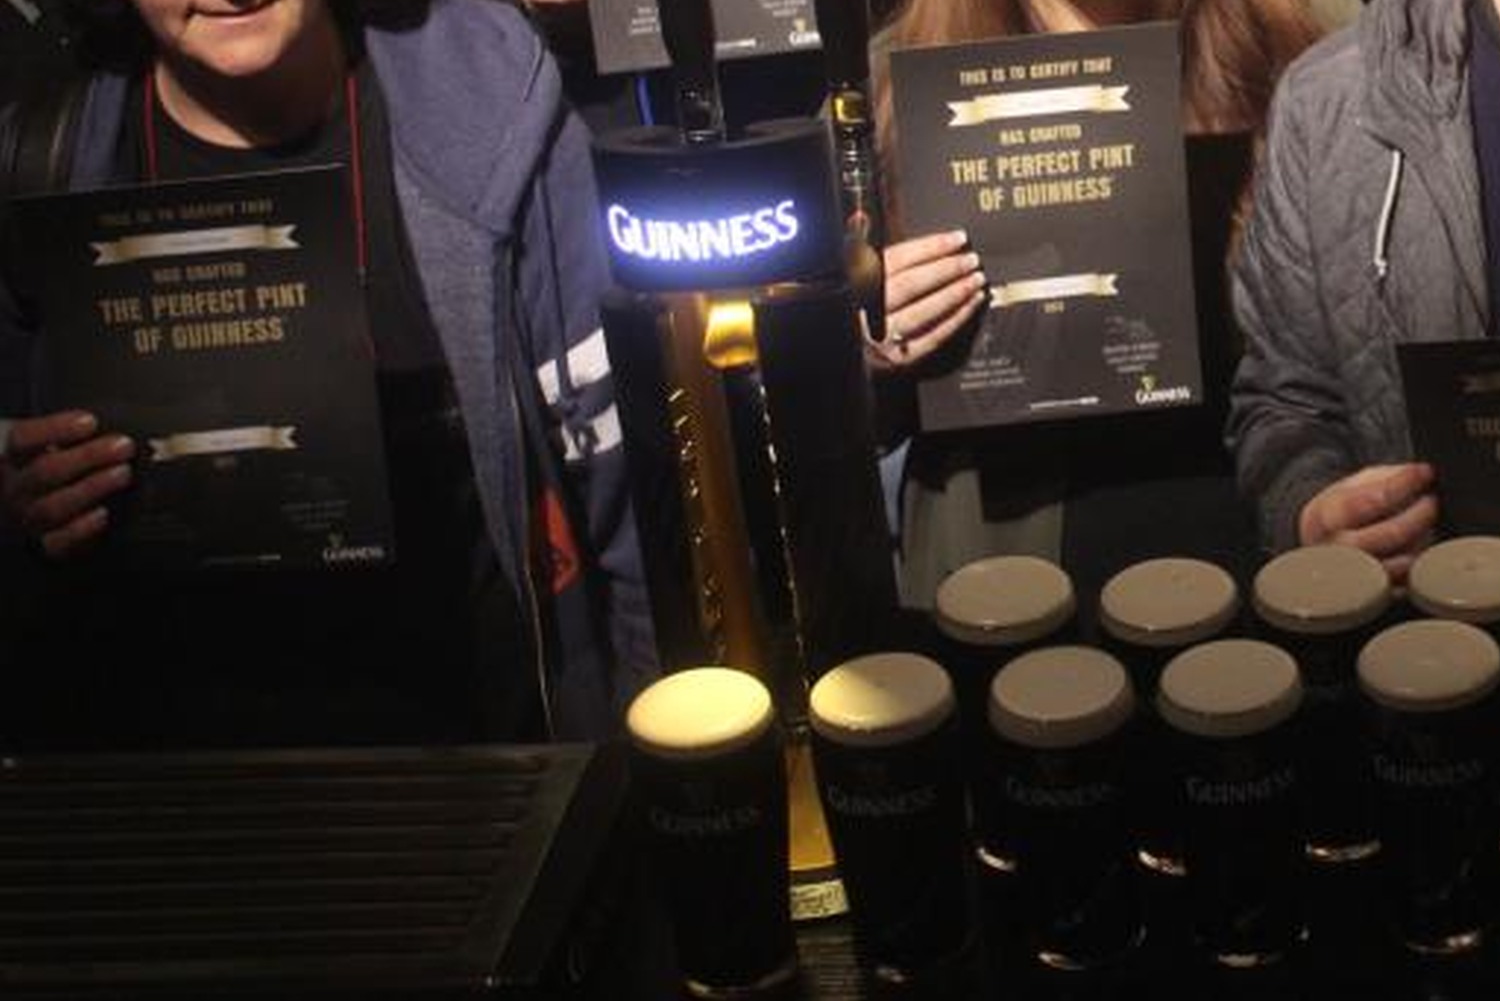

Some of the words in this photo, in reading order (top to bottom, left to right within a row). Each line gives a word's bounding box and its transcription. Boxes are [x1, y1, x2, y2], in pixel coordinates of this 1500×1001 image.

[959, 68, 988, 86] THIS
[992, 67, 1006, 83] IS
[1009, 65, 1026, 80] TO
[1029, 60, 1079, 79] CERTIFY
[1082, 56, 1112, 74] THAT
[1000, 129, 1026, 146] HAS
[951, 157, 989, 185] THE
[997, 149, 1081, 180] PERFECT
[1089, 143, 1135, 170] PINT
[979, 186, 1005, 212] OF
[1012, 176, 1112, 209] GUINNESS
[607, 199, 799, 261] GUINNESS
[101, 297, 142, 326] THE
[152, 288, 247, 322] PERFECT
[256, 281, 307, 310] PINT
[133, 328, 162, 355] OF
[172, 315, 285, 350] GUINNESS
